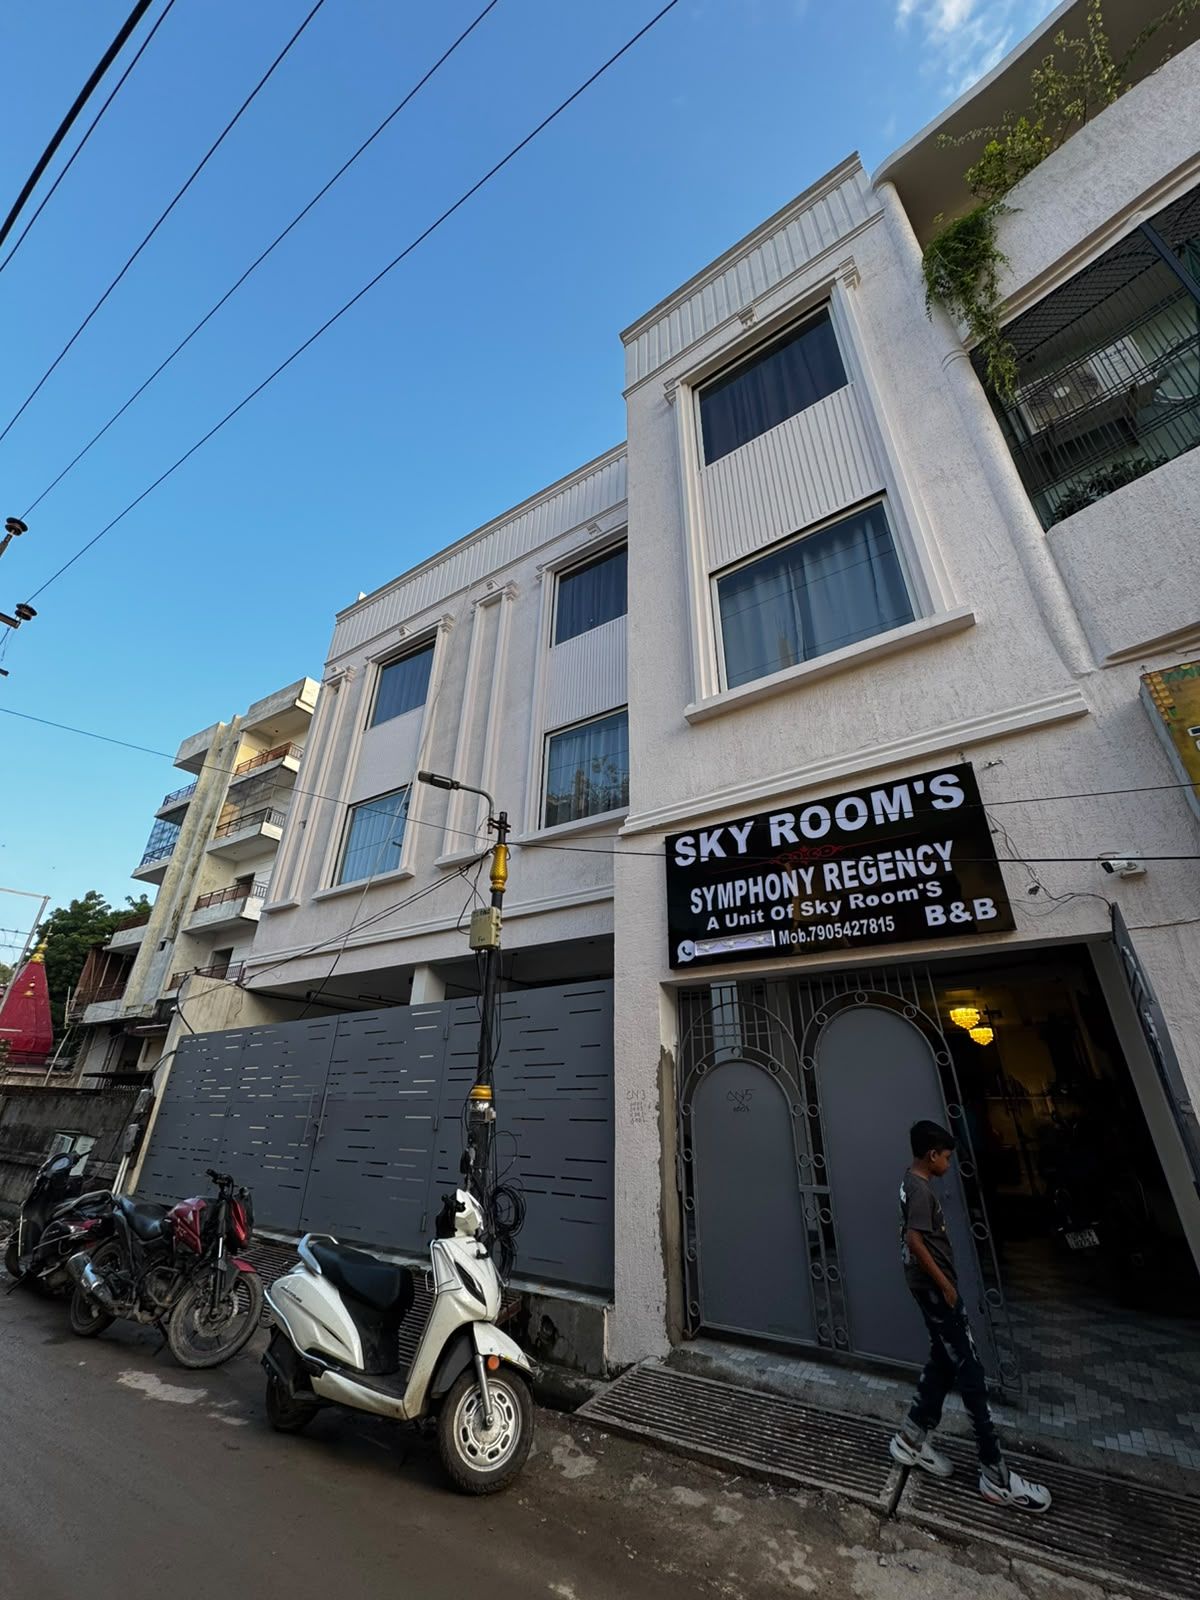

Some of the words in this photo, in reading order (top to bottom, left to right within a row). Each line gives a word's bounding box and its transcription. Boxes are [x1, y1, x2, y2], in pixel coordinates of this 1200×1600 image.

[674, 821, 754, 867] SKY
[770, 772, 965, 847] ROOM'S
[690, 865, 815, 915] SYMPHONY
[823, 840, 954, 892] REGENCY
[706, 916, 720, 931] A
[725, 907, 765, 928] Unit
[771, 904, 796, 922] Of
[800, 895, 842, 918] Sky
[849, 880, 944, 909] Room'S
[778, 916, 896, 946] Mob.7905427815
[924, 897, 998, 927] B&B
